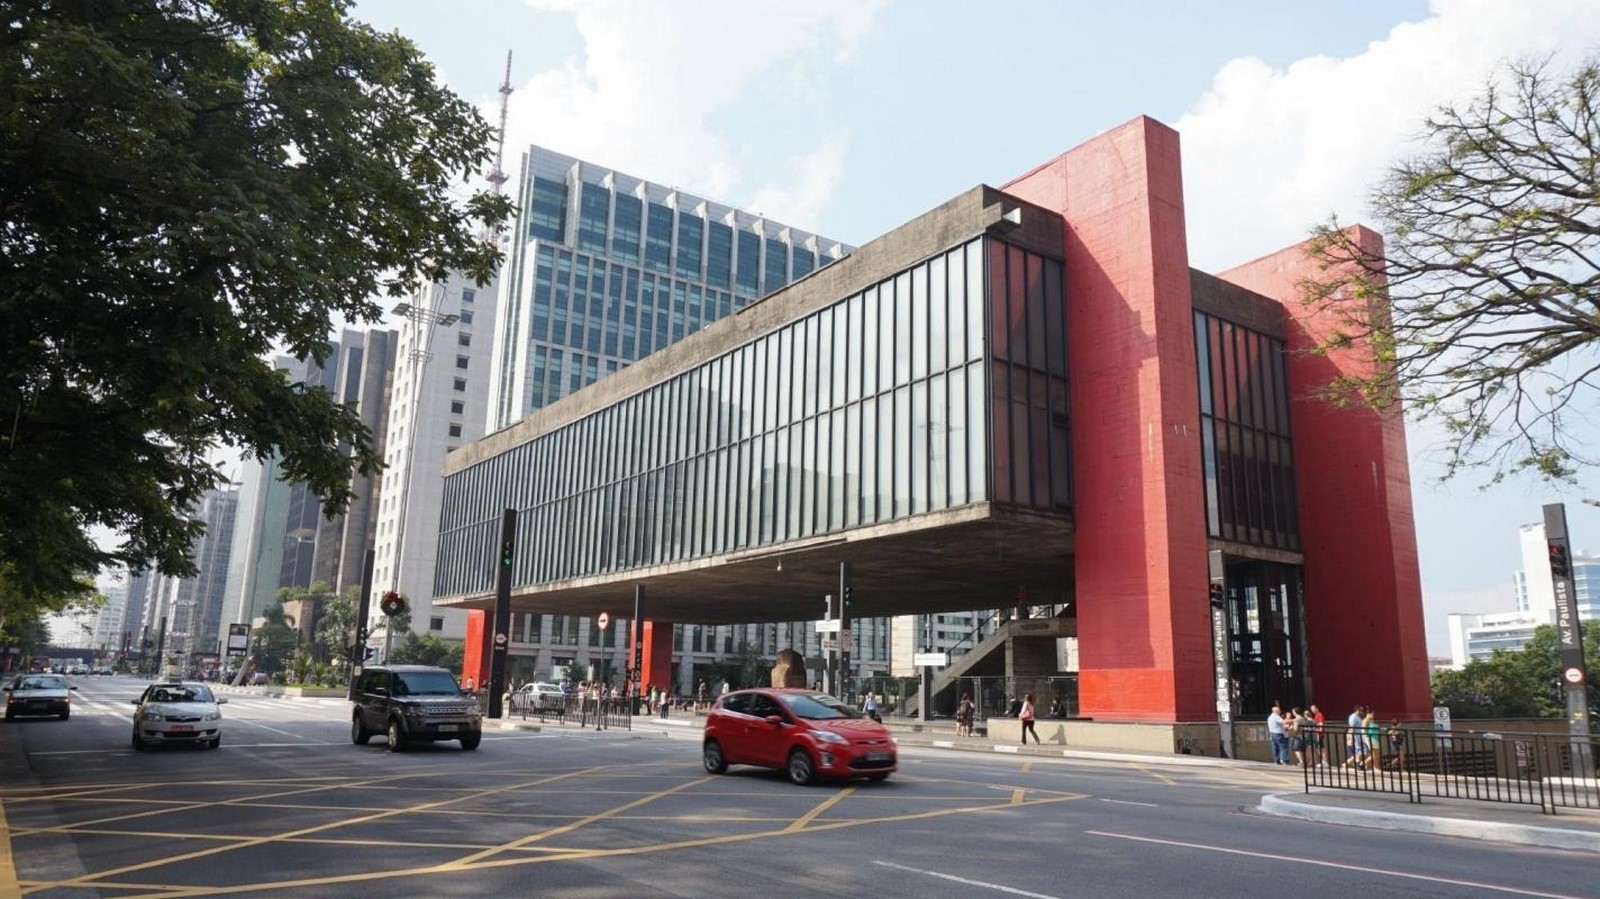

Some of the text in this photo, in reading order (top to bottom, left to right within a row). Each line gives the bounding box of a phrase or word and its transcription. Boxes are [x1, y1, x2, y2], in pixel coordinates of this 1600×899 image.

[1214, 610, 1223, 647] Paulista
[1556, 581, 1573, 645] Av. Paulista
